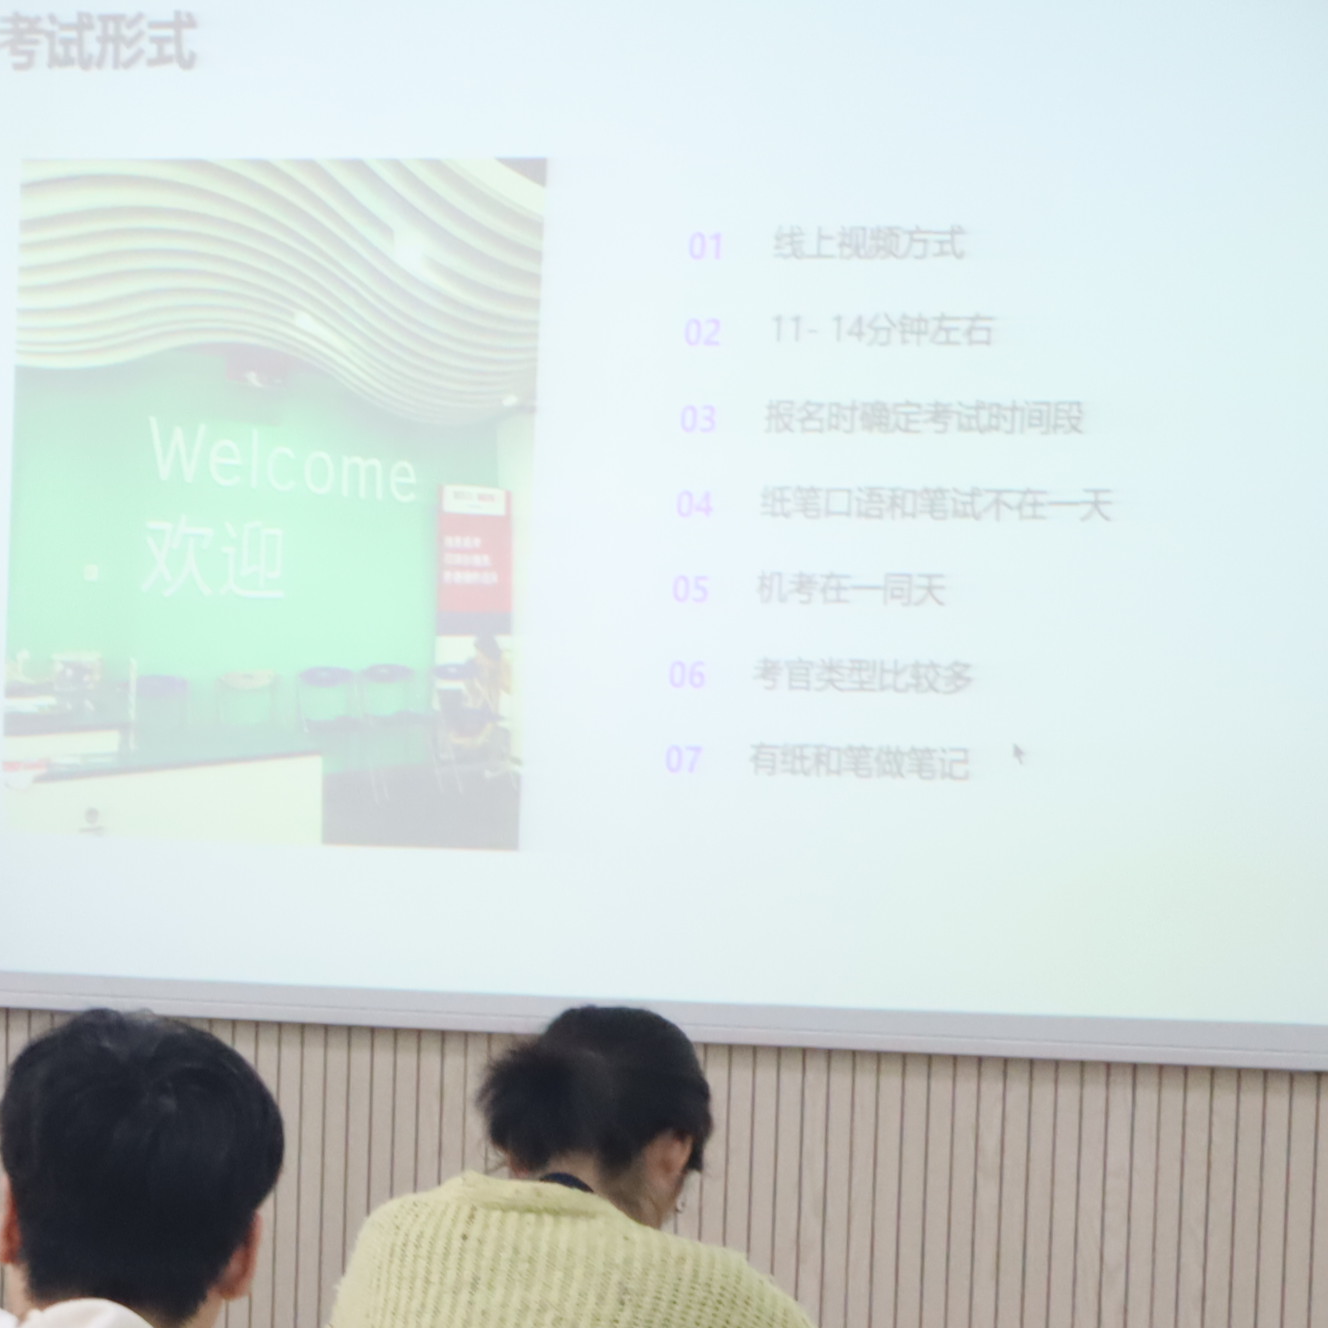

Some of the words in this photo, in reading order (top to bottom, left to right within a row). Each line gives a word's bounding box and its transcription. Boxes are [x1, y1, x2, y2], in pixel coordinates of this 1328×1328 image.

[688, 232, 724, 260] 01
[773, 225, 967, 261] 线上视频方式
[684, 318, 721, 347] 02
[680, 404, 717, 433] 03
[764, 399, 1085, 435] 报名时确定考试时间段
[148, 415, 417, 503] Welcome
[676, 490, 714, 518] 04
[760, 485, 1113, 522] 纸笔口语和笔试不在一天
[142, 514, 286, 599] 欢迎
[672, 575, 709, 603] 05
[756, 570, 947, 607] 机考在一同天
[668, 660, 706, 688] 06
[752, 656, 975, 695] 考官类型比较多
[664, 745, 703, 774] 07
[749, 741, 971, 781] 有纸和笔做笔记
